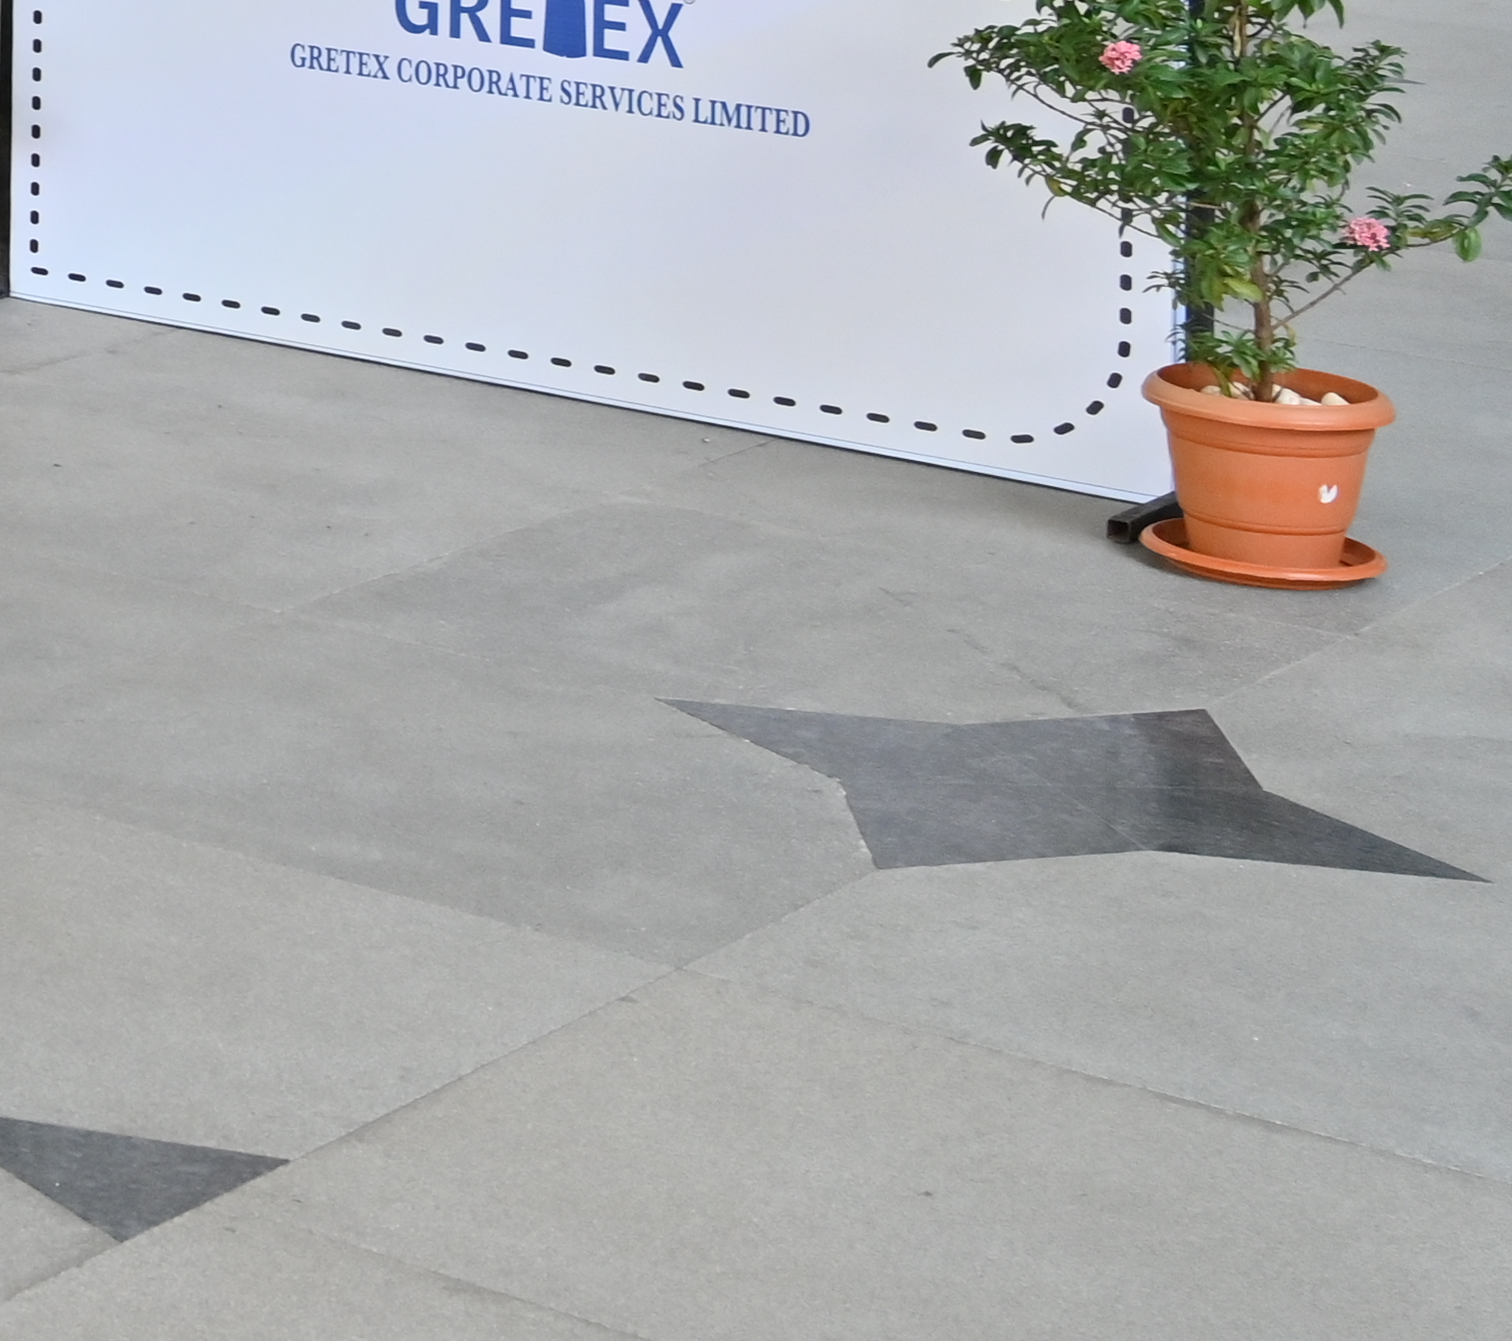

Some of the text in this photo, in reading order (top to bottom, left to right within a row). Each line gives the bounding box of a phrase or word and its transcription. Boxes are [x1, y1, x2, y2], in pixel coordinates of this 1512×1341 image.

[291, 43, 810, 137] GRETEX CORPORATE SERVICES LIMITED
